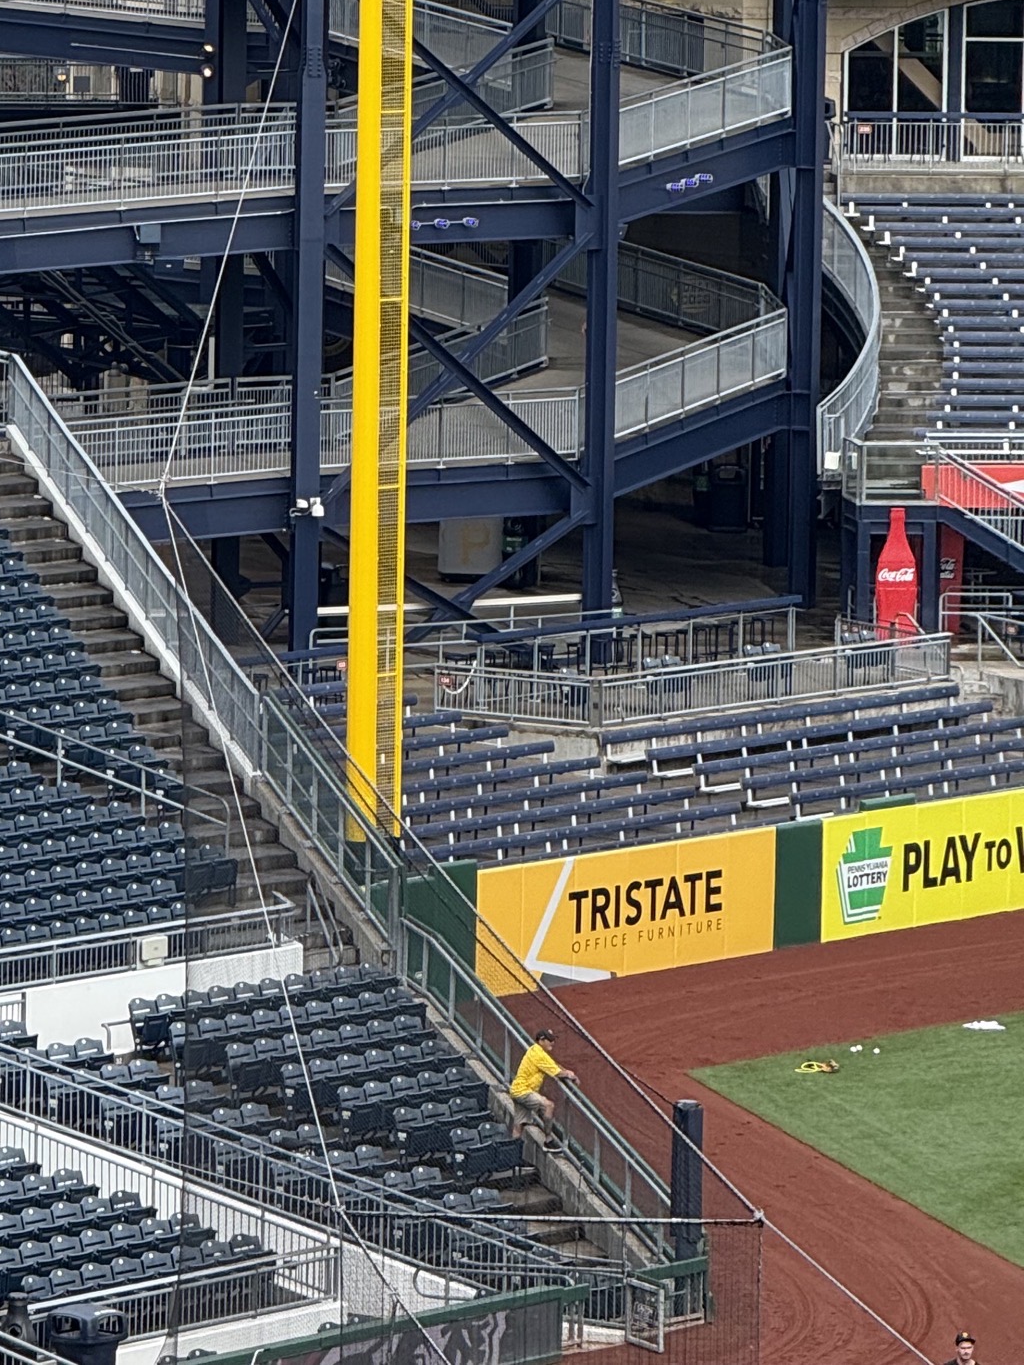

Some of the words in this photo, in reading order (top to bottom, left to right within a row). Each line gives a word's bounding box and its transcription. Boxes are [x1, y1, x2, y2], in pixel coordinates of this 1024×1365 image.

[847, 870, 888, 889] LOTTERY
[902, 832, 982, 892] PLAY
[984, 838, 1012, 872] TO
[568, 869, 723, 934] TRISTATE
[571, 932, 627, 954] OFFICE
[638, 918, 723, 943] FURNITURE
